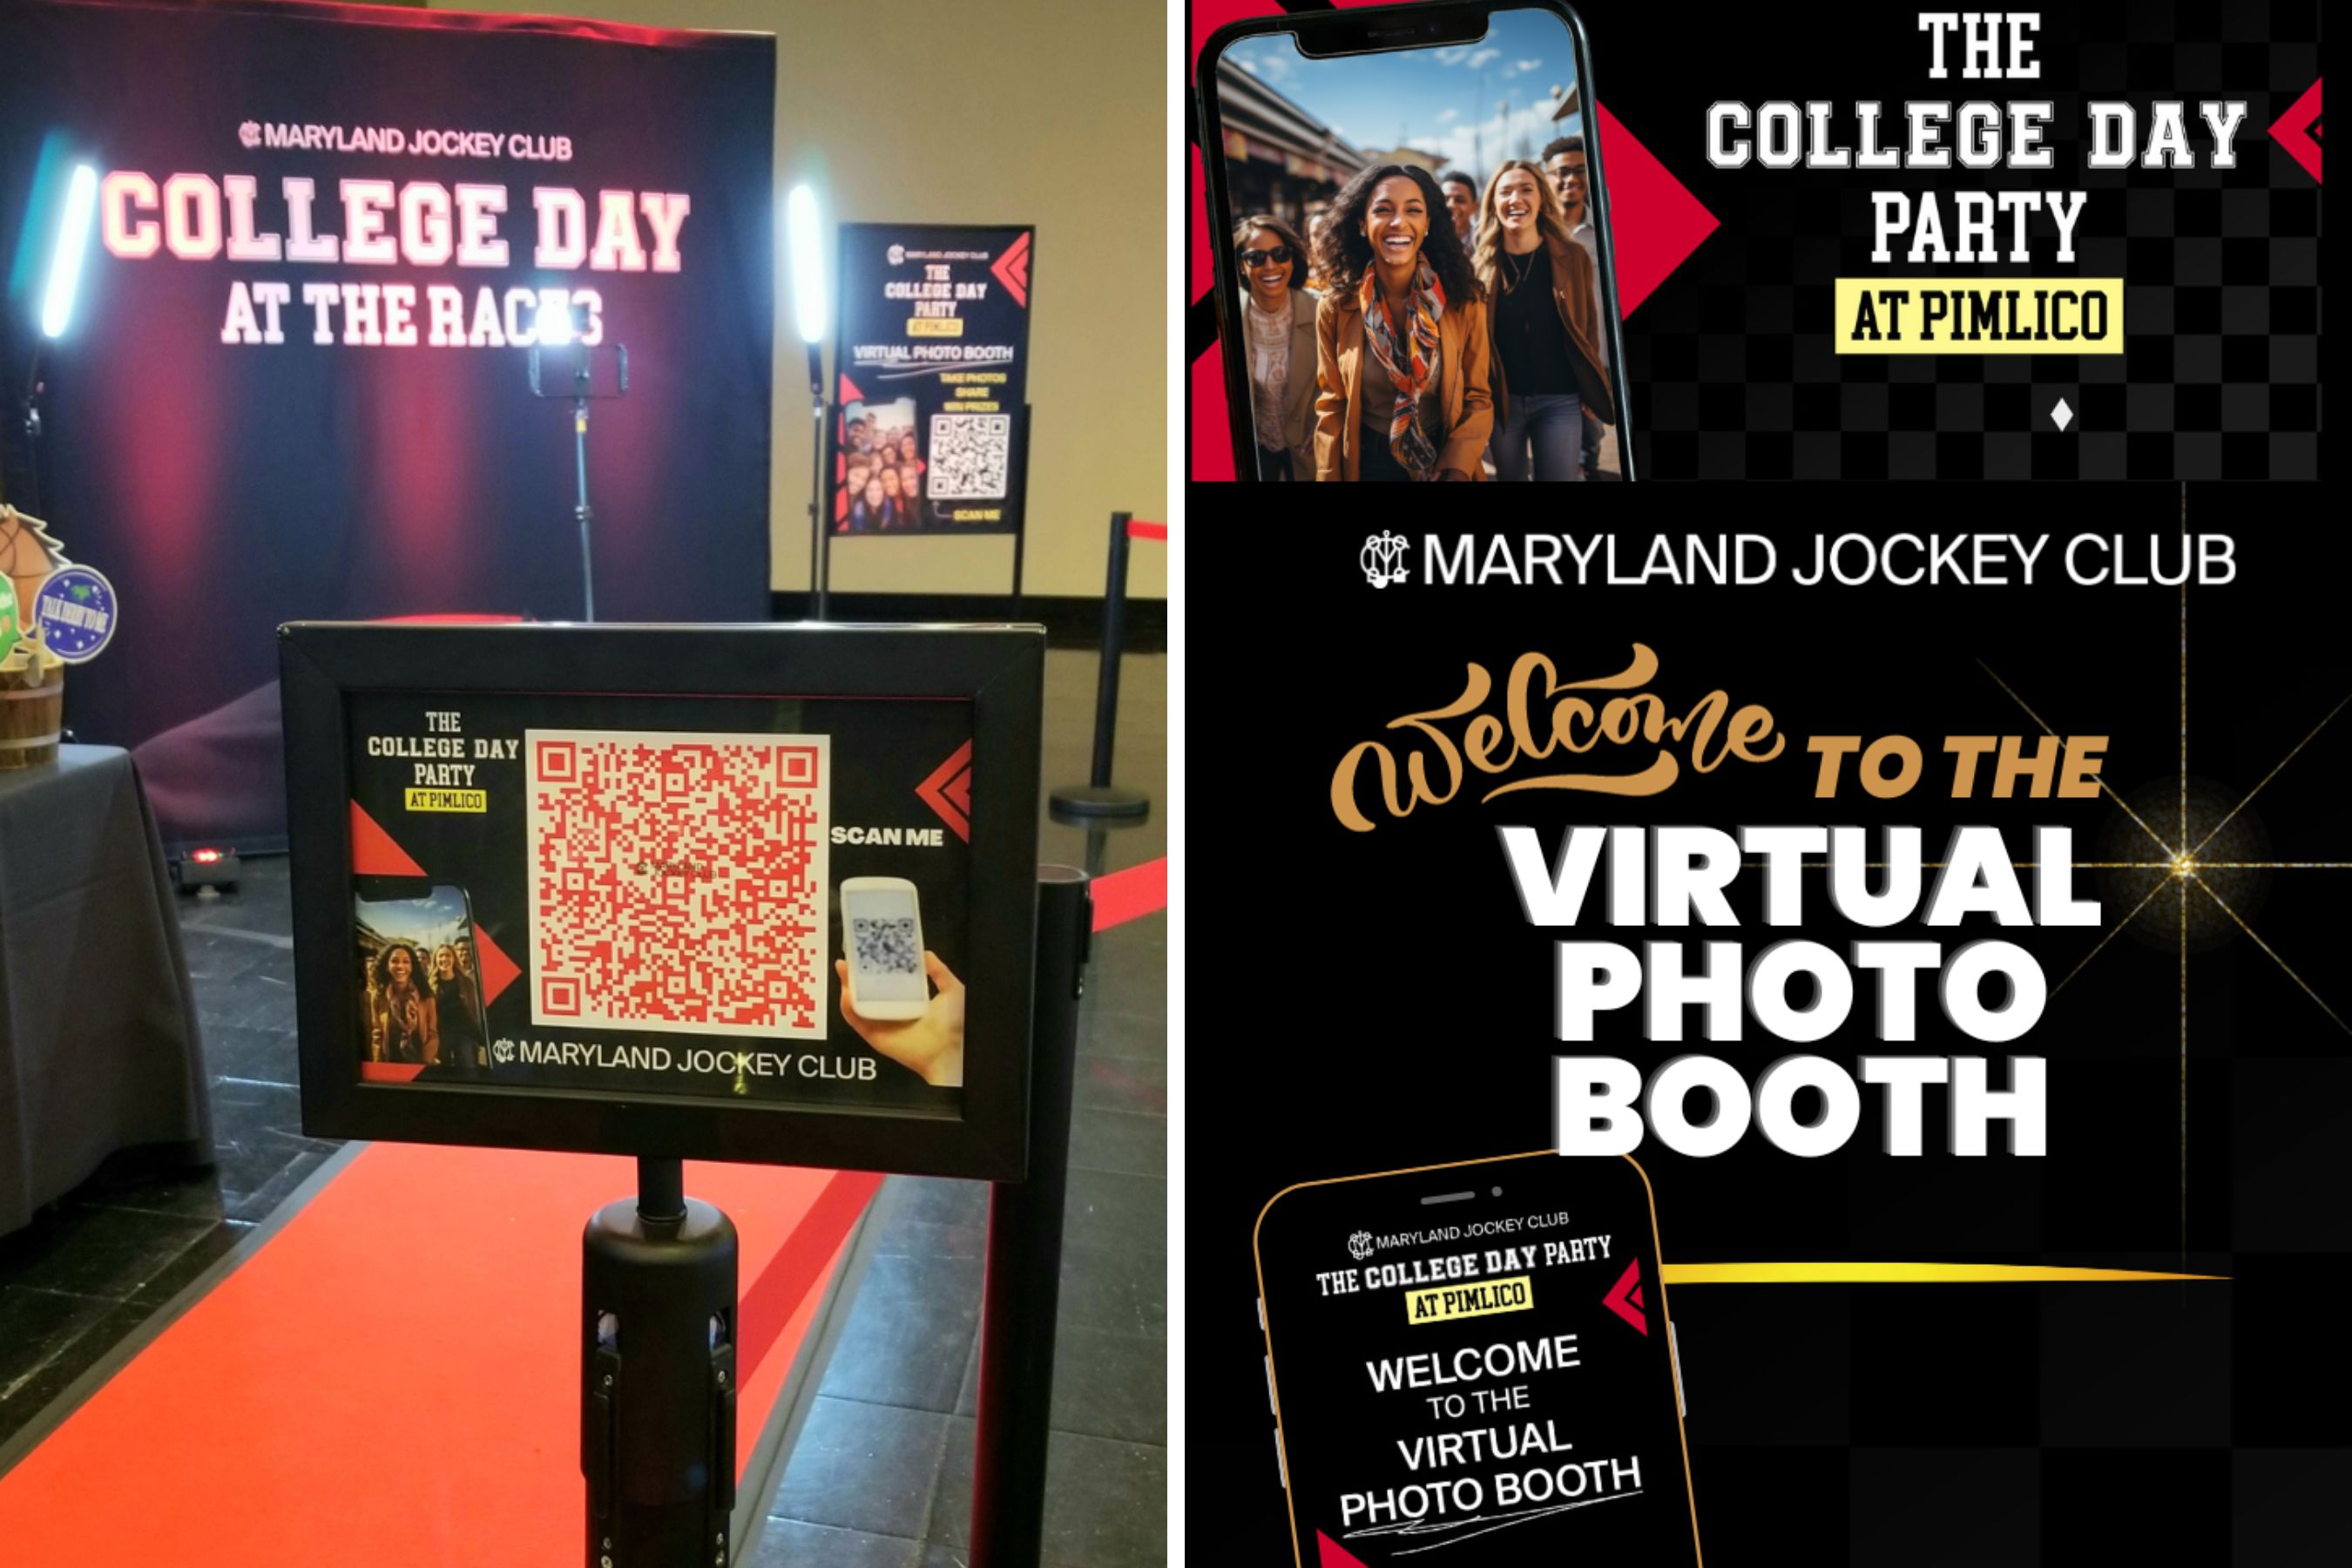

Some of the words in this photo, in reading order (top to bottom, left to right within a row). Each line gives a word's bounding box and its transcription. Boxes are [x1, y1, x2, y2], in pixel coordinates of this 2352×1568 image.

[1918, 12, 2040, 78] THE
[264, 123, 405, 153] MARYLAND
[408, 129, 505, 158] JOCKEY
[508, 133, 573, 161] CLUB
[1707, 101, 2054, 169] COLLEGE
[2087, 101, 2247, 169] DAY
[101, 171, 510, 267] COLLEGE
[533, 186, 692, 272] DAY
[1871, 191, 2087, 263] PARTY
[885, 281, 952, 299] COLLEGE
[955, 281, 987, 300] DAY
[925, 264, 950, 280] THE
[220, 281, 290, 344] AT
[302, 283, 418, 347] THE
[427, 285, 603, 348] RACS
[914, 301, 957, 317] PARTY
[1851, 290, 1909, 341] AT
[1920, 290, 2108, 341] PIMLICO
[854, 345, 910, 360] VIRTUAL
[913, 346, 962, 361] PHOTO
[963, 346, 1013, 361] BOOTH
[1424, 534, 1777, 585] MARYLAND
[1792, 532, 2051, 586] JOCKEY
[2065, 532, 2236, 586] CLUB
[425, 711, 462, 733] THE
[1330, 643, 1786, 832] Welcome
[1807, 735, 1923, 799] TO
[1943, 735, 2109, 798] THE
[368, 736, 466, 759] COLLEGE
[474, 739, 519, 760] DAY
[410, 792, 427, 808] AT
[429, 794, 483, 809] PIMLICO
[414, 763, 476, 787] PARTY
[830, 826, 902, 846] SCAN
[905, 828, 943, 847] ME
[1497, 825, 2102, 928] VIRTUAL
[1554, 939, 2047, 1043] PHOTO
[519, 1040, 672, 1071] MARYLAND
[677, 1049, 791, 1078] JOCKEY
[798, 1054, 876, 1081] CLUB
[1551, 1054, 2047, 1158] BOOTH
[1376, 1227, 1460, 1249] MARYLAND
[1463, 1217, 1524, 1238] JOCKEY
[1527, 1211, 1570, 1229] CLUB
[1316, 1268, 1360, 1296] THE
[1364, 1253, 1479, 1289] COLLEGE
[1484, 1244, 1538, 1274] DAY
[1544, 1234, 1612, 1266] PARTY
[1415, 1294, 1440, 1319] AT
[1443, 1282, 1526, 1315] PIMLICO
[1366, 1335, 1581, 1392] WELCOME
[1426, 1394, 1466, 1420] TO
[1471, 1385, 1531, 1413] THE
[1396, 1419, 1572, 1471] VIRTUAL
[1340, 1477, 1483, 1527] PHOTO
[1495, 1455, 1642, 1506] BOOTH
